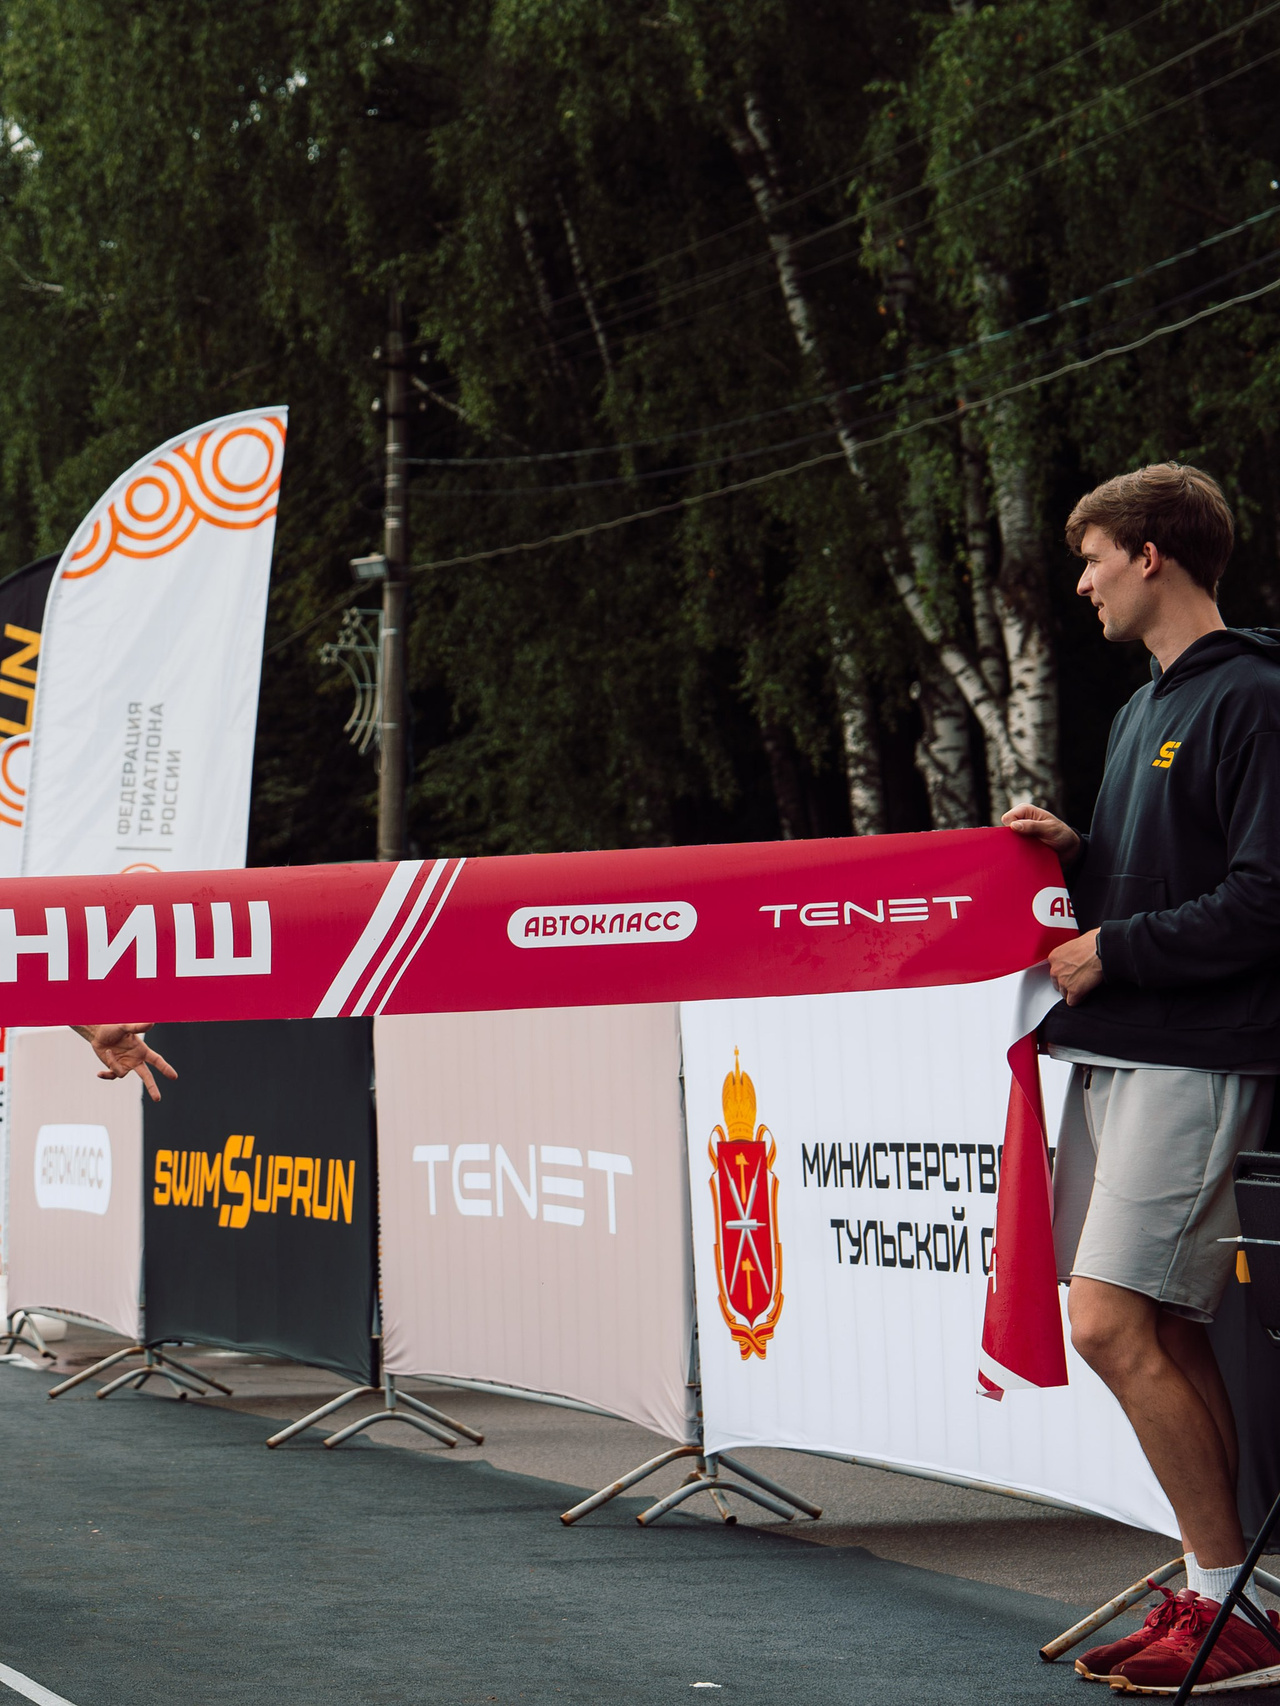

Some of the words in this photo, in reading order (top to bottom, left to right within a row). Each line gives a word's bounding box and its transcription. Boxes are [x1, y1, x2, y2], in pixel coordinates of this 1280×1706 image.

[117, 702, 142, 835] ФЕДЕРАЦИЯ
[138, 702, 164, 835] ТРИАТЛОНА
[160, 750, 181, 835] РОССИИ
[523, 911, 681, 938] АВТОКЛАСС
[758, 895, 973, 928] TENET
[41, 1145, 104, 1190] АВТОКЛАСС
[412, 1142, 634, 1235] TENET
[801, 1142, 1003, 1194] МИНИСТЕРСТВ
[830, 1206, 971, 1275] ТУЛЬСКОЙ
